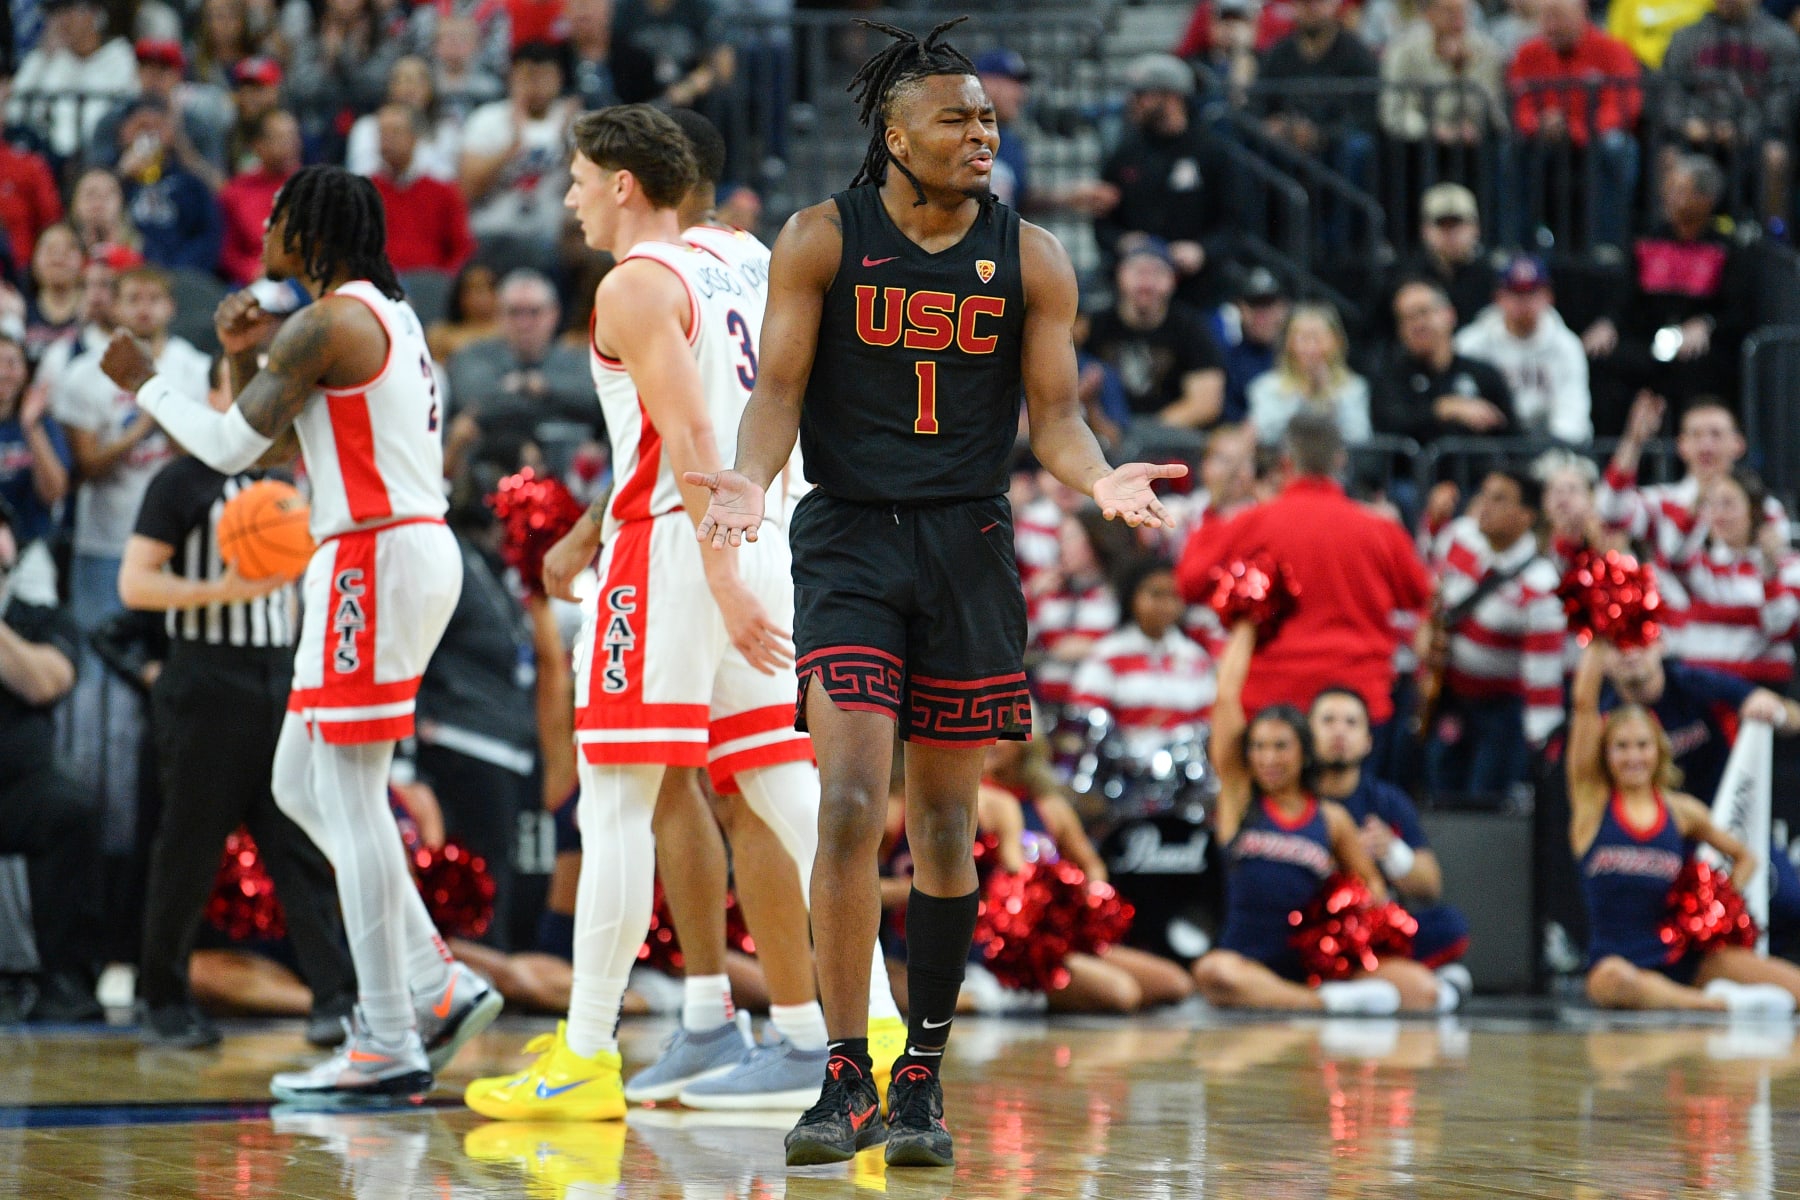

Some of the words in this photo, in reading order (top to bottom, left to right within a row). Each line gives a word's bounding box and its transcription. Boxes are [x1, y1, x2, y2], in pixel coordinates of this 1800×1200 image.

[726, 308, 759, 392] 3
[855, 285, 1006, 354] USC
[914, 361, 939, 435] 1
[333, 567, 367, 675] CATS
[602, 584, 637, 695] CATS
